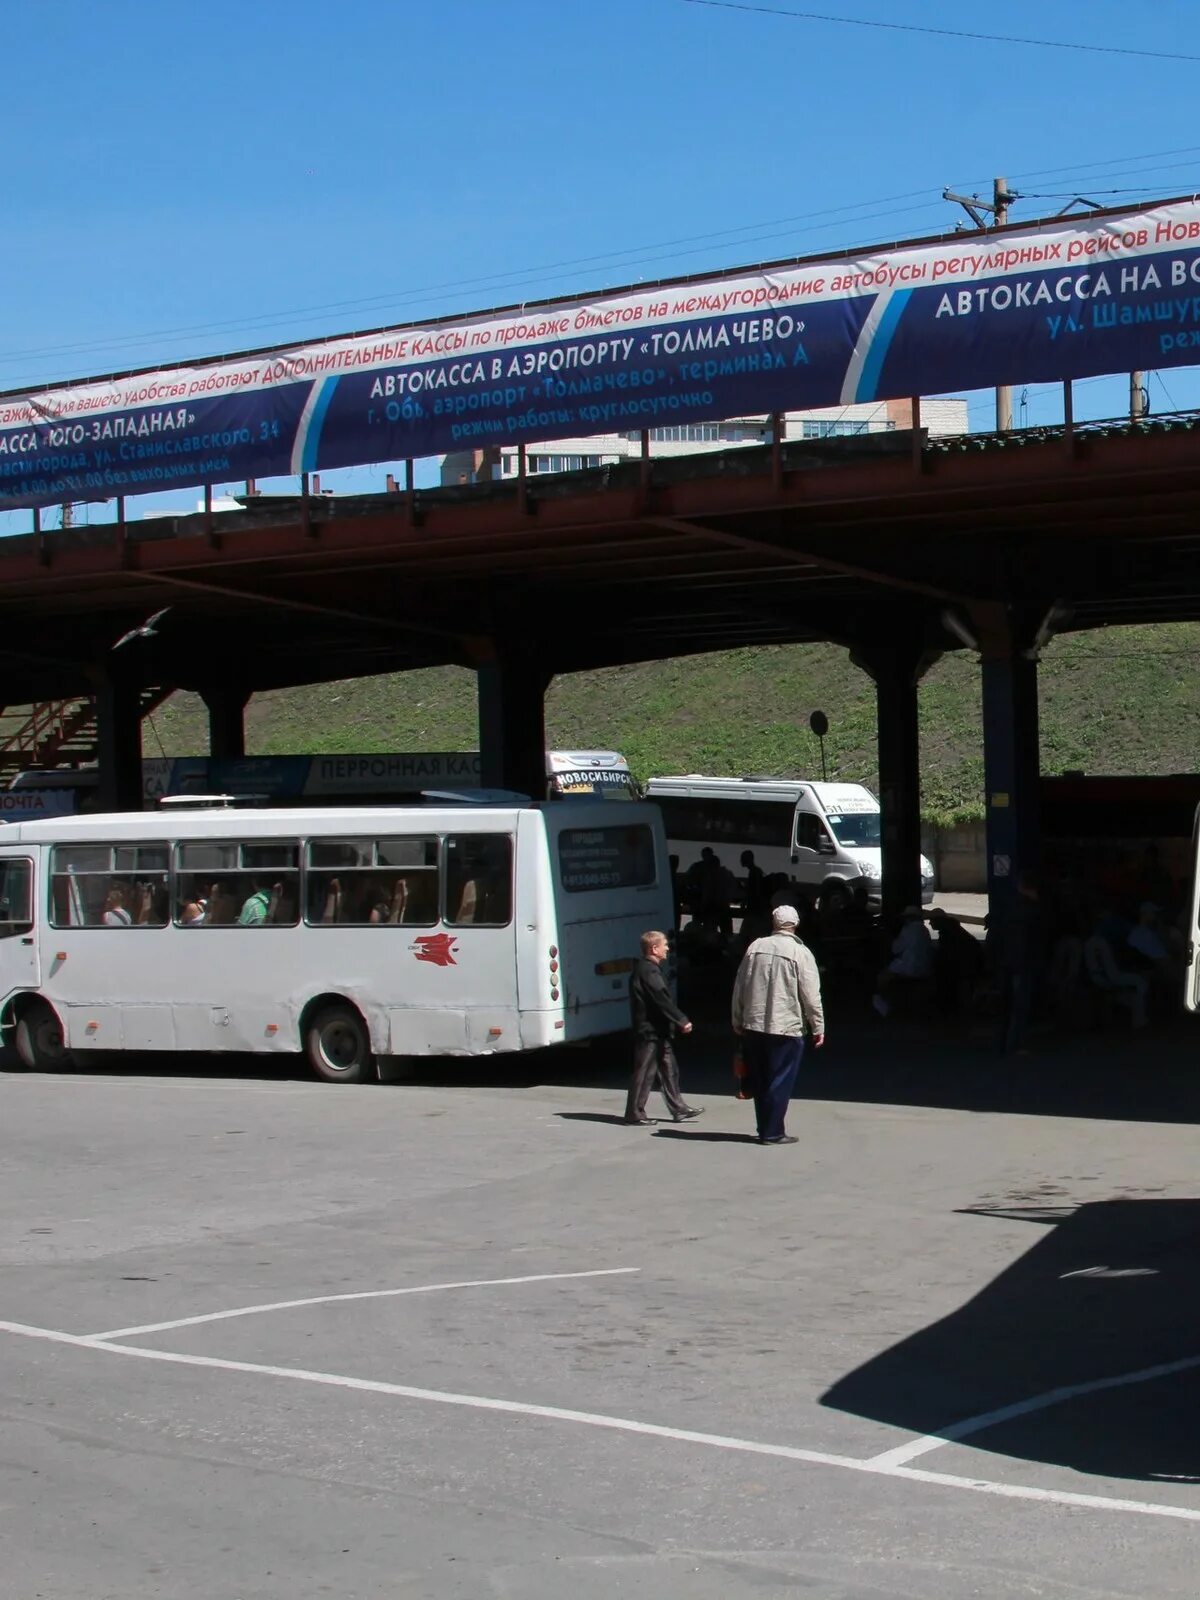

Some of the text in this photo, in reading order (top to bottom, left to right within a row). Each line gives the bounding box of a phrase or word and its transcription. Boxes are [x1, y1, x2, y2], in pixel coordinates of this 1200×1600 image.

[935, 272, 1111, 318] АВТОКАССА
[1121, 264, 1162, 293] НА
[77, 394, 121, 410] вашего
[124, 381, 187, 407] удобства
[188, 370, 259, 397] работают
[262, 340, 408, 384] ДОПОЛНИТЕЛЬНЫЕ
[412, 330, 467, 355] КАССЫ
[471, 331, 492, 346] по
[495, 318, 568, 345] продаже
[574, 303, 643, 330] билетов
[647, 302, 668, 318] на
[672, 279, 824, 314] междугородние
[830, 262, 926, 292] автобусы
[932, 243, 1062, 280] регулярных
[1067, 229, 1148, 261] рейсов
[1047, 314, 1084, 341] ул.
[370, 315, 805, 399] АВТОКАССА В АЭРОПОРТУ «ТОЛМАЧЕВО»
[433, 385, 526, 415] аэропорт
[680, 352, 787, 382] терминал
[793, 343, 809, 366] А
[452, 390, 713, 441] режим работы: круглосуточно
[95, 449, 116, 469] ул.
[119, 425, 255, 461] Станиславского,
[104, 468, 129, 485] без
[132, 462, 195, 480] выходных
[321, 758, 440, 779] ПЕРРОННАЯ
[556, 771, 632, 785] НОВОСИБИРСК
